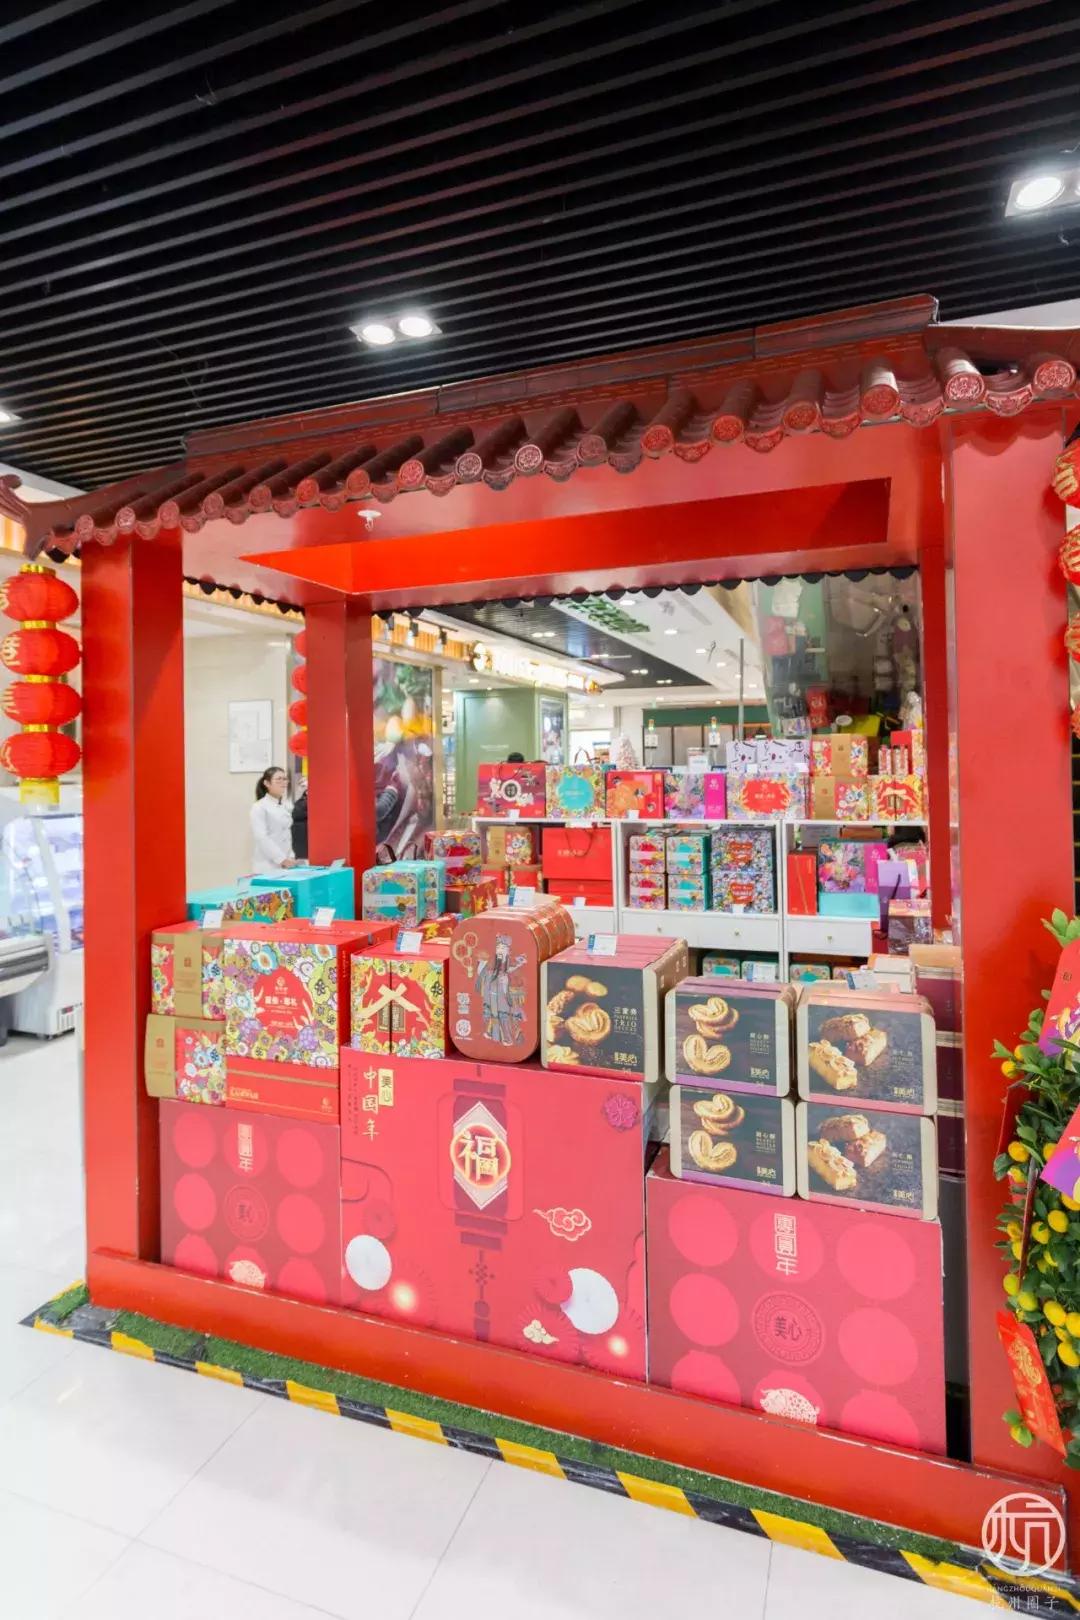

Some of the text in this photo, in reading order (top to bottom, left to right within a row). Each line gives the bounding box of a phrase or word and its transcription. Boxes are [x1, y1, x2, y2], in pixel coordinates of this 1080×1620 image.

[614, 1019, 637, 1030] TRIO
[380, 1075, 392, 1102] 美心
[774, 1315, 802, 1341] 美心
